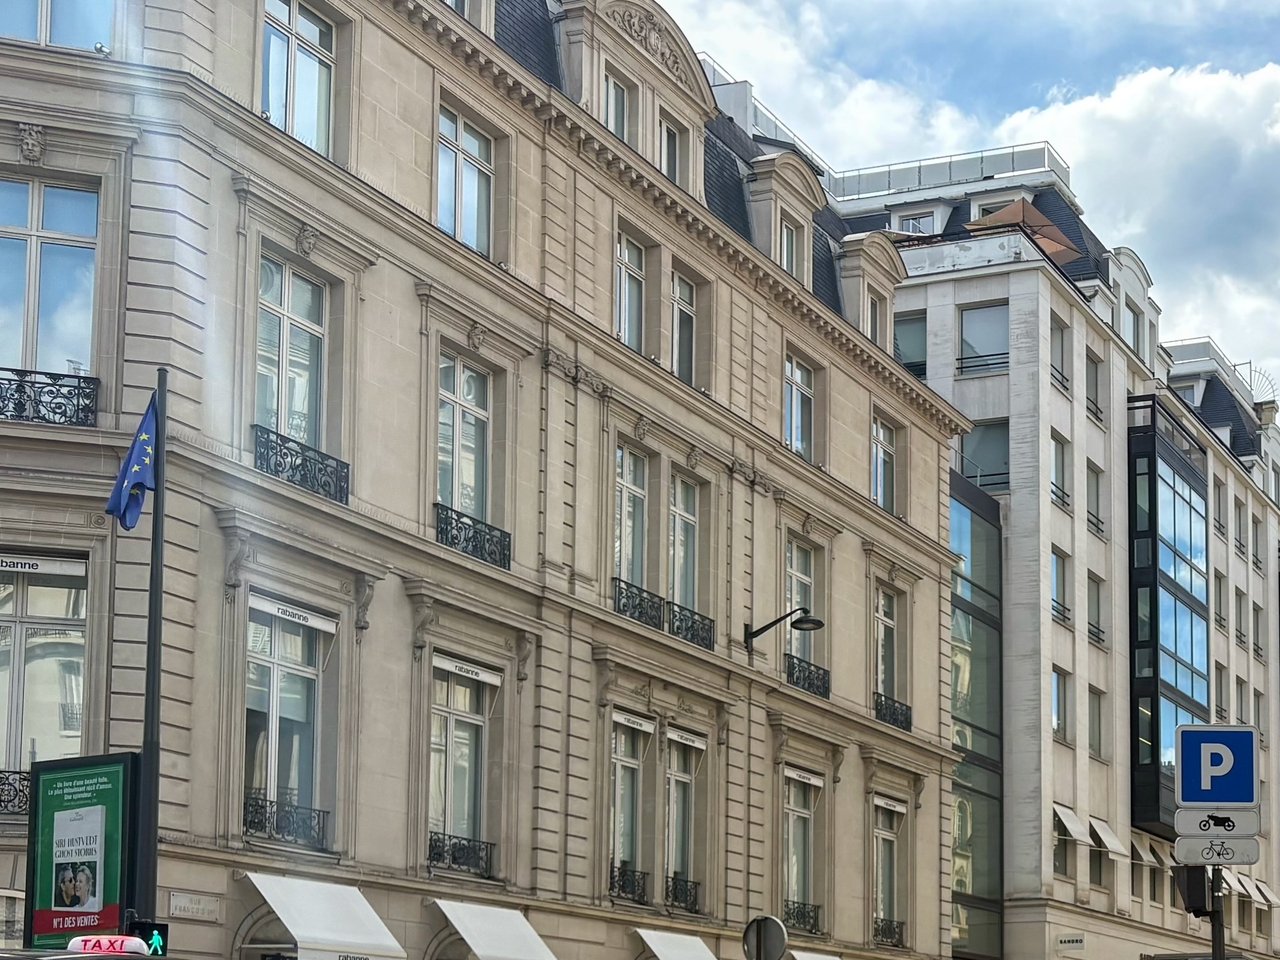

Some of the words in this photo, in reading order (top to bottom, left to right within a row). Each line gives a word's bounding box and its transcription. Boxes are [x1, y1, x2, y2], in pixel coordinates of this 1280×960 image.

[0, 559, 39, 571] banne
[277, 607, 309, 623] rabanne
[454, 664, 480, 678] rabanne
[1200, 742, 1235, 790] P
[64, 917, 75, 928] DES
[76, 914, 99, 927] VENTES
[81, 939, 125, 951] TAXI
